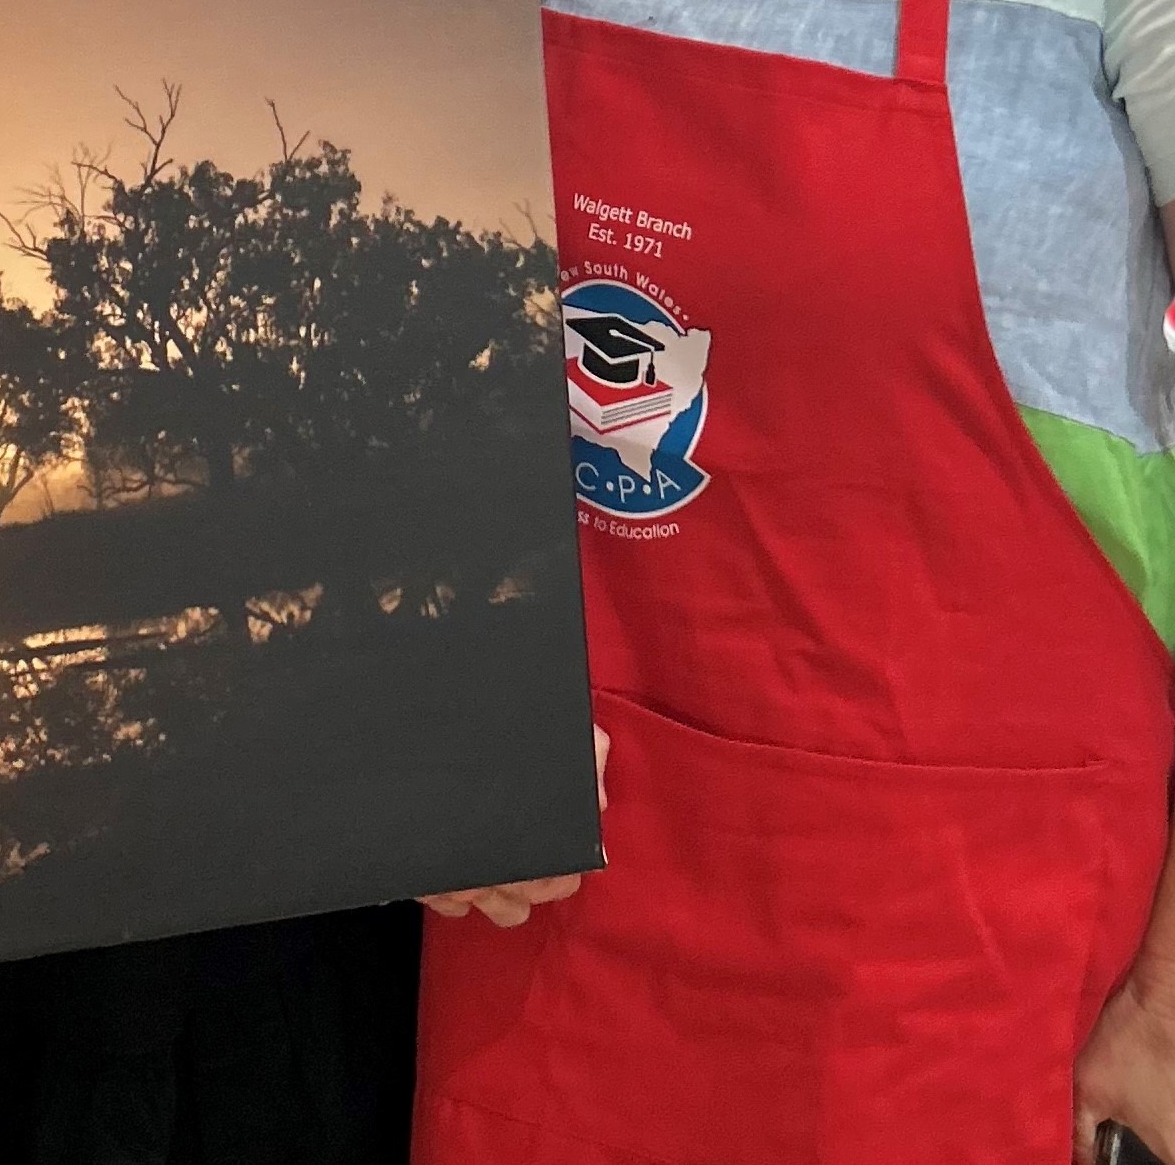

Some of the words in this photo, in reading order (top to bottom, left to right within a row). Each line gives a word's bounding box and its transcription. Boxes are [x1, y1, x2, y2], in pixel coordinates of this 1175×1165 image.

[573, 192, 633, 225] Walgett
[636, 210, 692, 240] Branch
[588, 222, 617, 245] Est.
[623, 233, 663, 258] 1971
[560, 266, 579, 282] ew
[584, 260, 628, 281] South
[593, 516, 608, 532] to
[609, 520, 681, 540] Education
